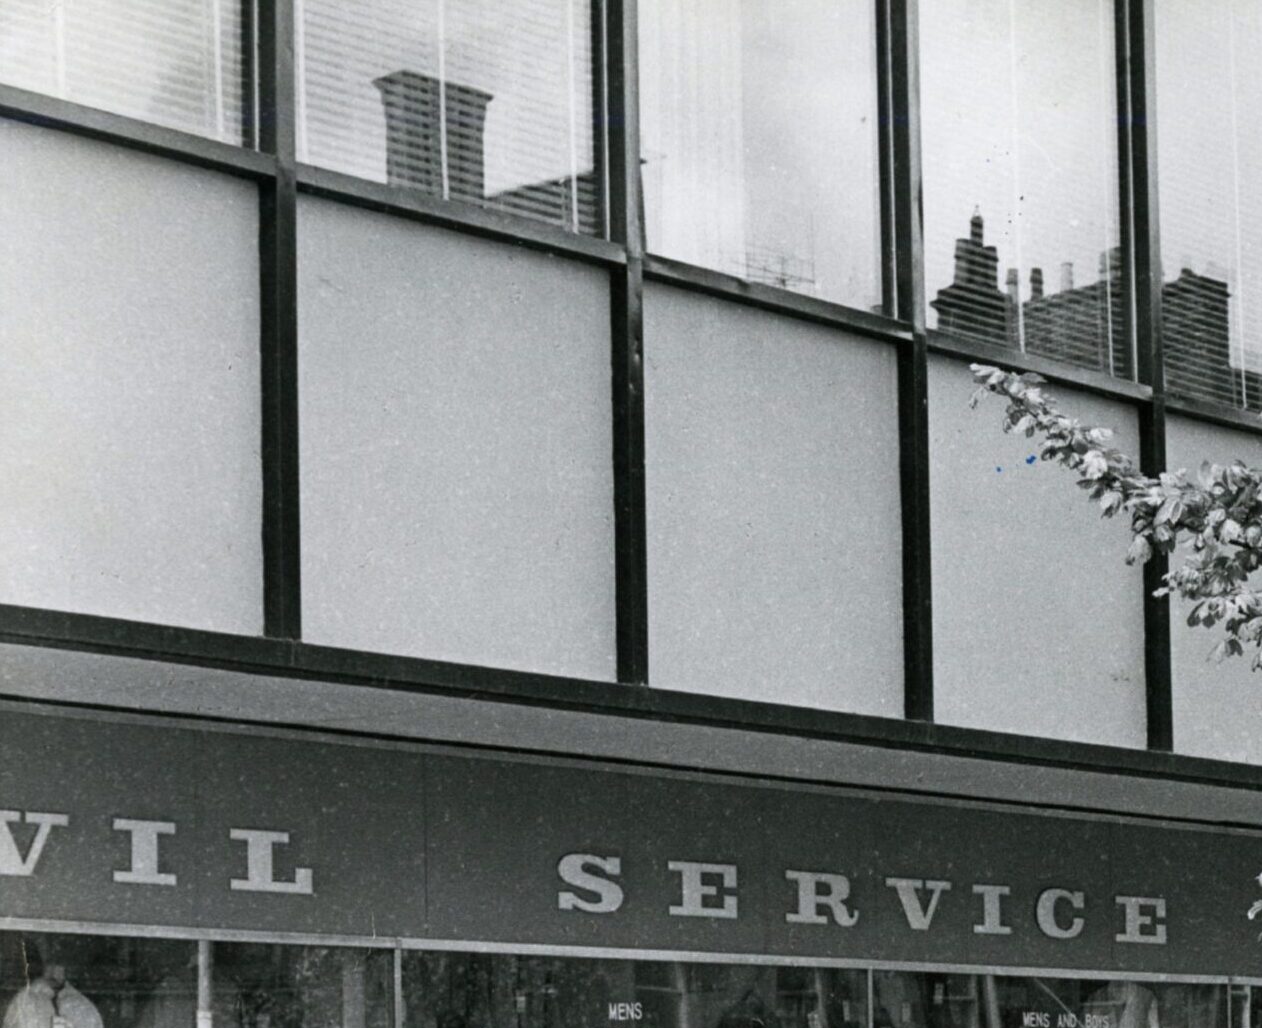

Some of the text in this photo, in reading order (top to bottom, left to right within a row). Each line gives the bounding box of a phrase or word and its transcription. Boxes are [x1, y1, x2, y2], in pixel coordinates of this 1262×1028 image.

[557, 852, 1168, 945] SERVICE
[608, 1002, 643, 1020] MENS
[1022, 1011, 1050, 1028] MENS
[1057, 1013, 1077, 1028] AND
